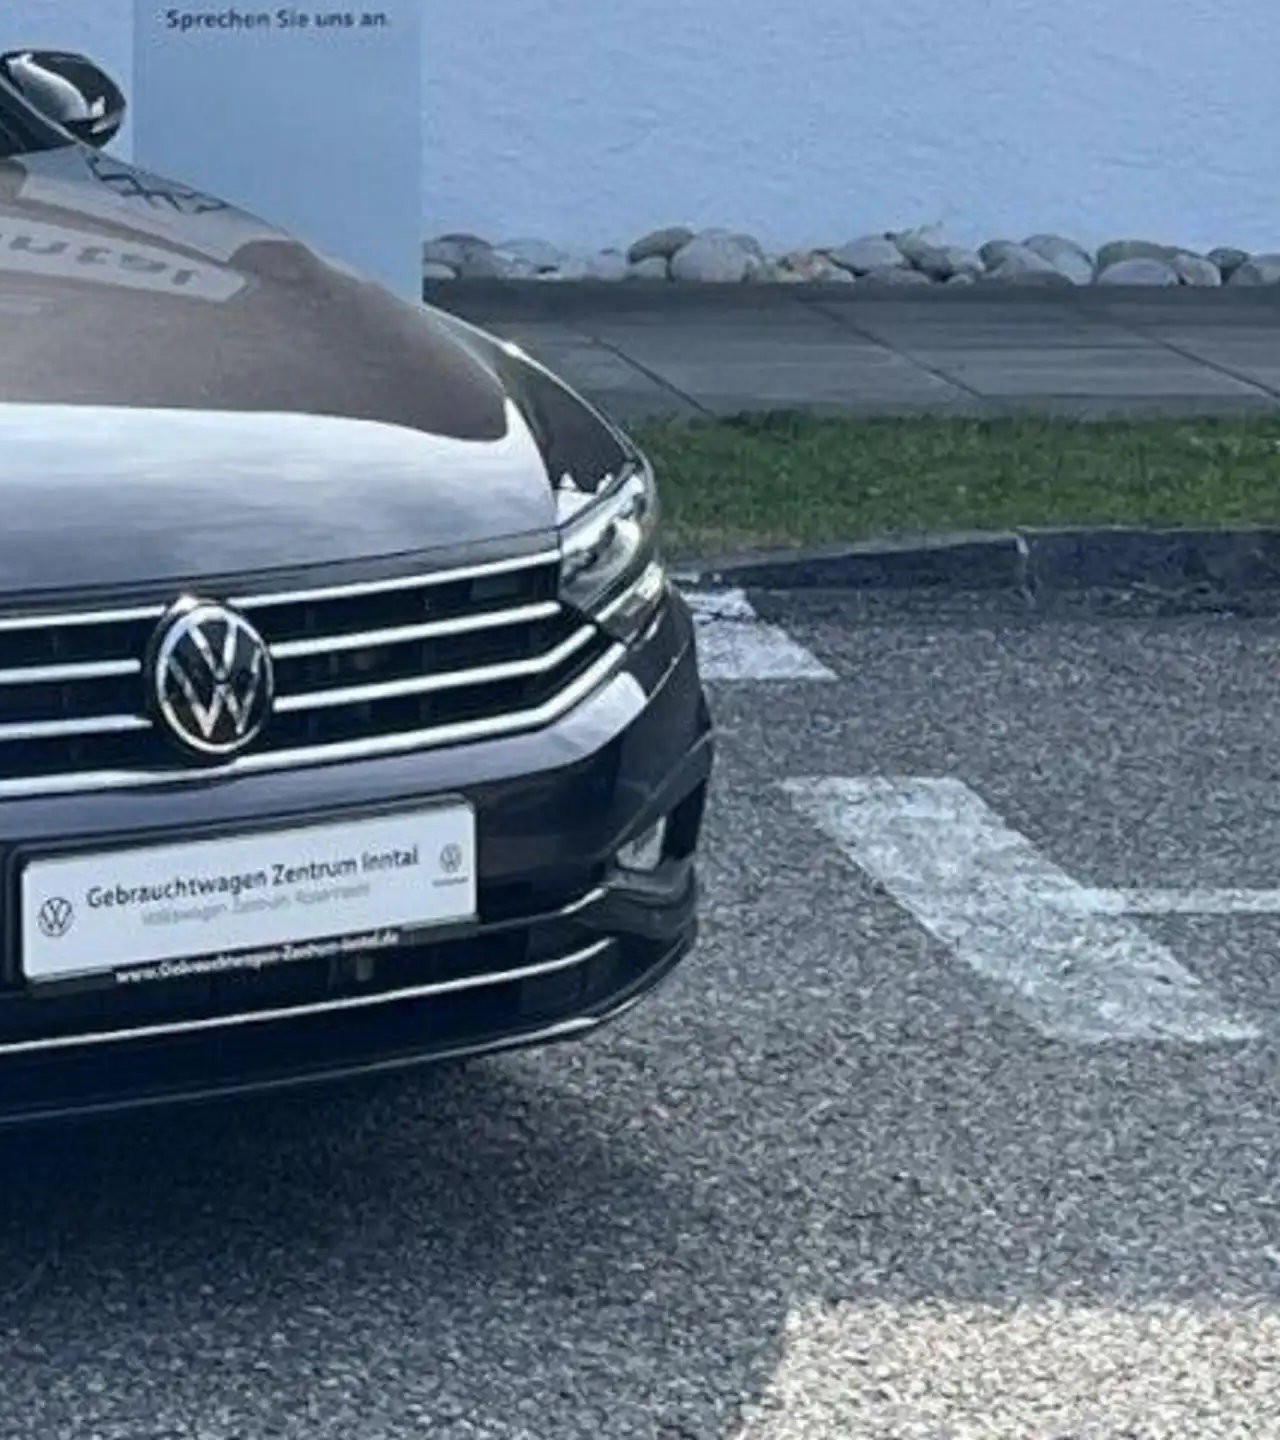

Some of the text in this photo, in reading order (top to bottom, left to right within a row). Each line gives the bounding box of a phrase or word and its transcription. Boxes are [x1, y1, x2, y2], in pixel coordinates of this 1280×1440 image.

[165, 9, 270, 33] Sprechen
[276, 10, 309, 28] Sie
[314, 12, 354, 28] uns
[87, 868, 267, 908] Gebrauchtwagen
[271, 858, 358, 888] Zentrum
